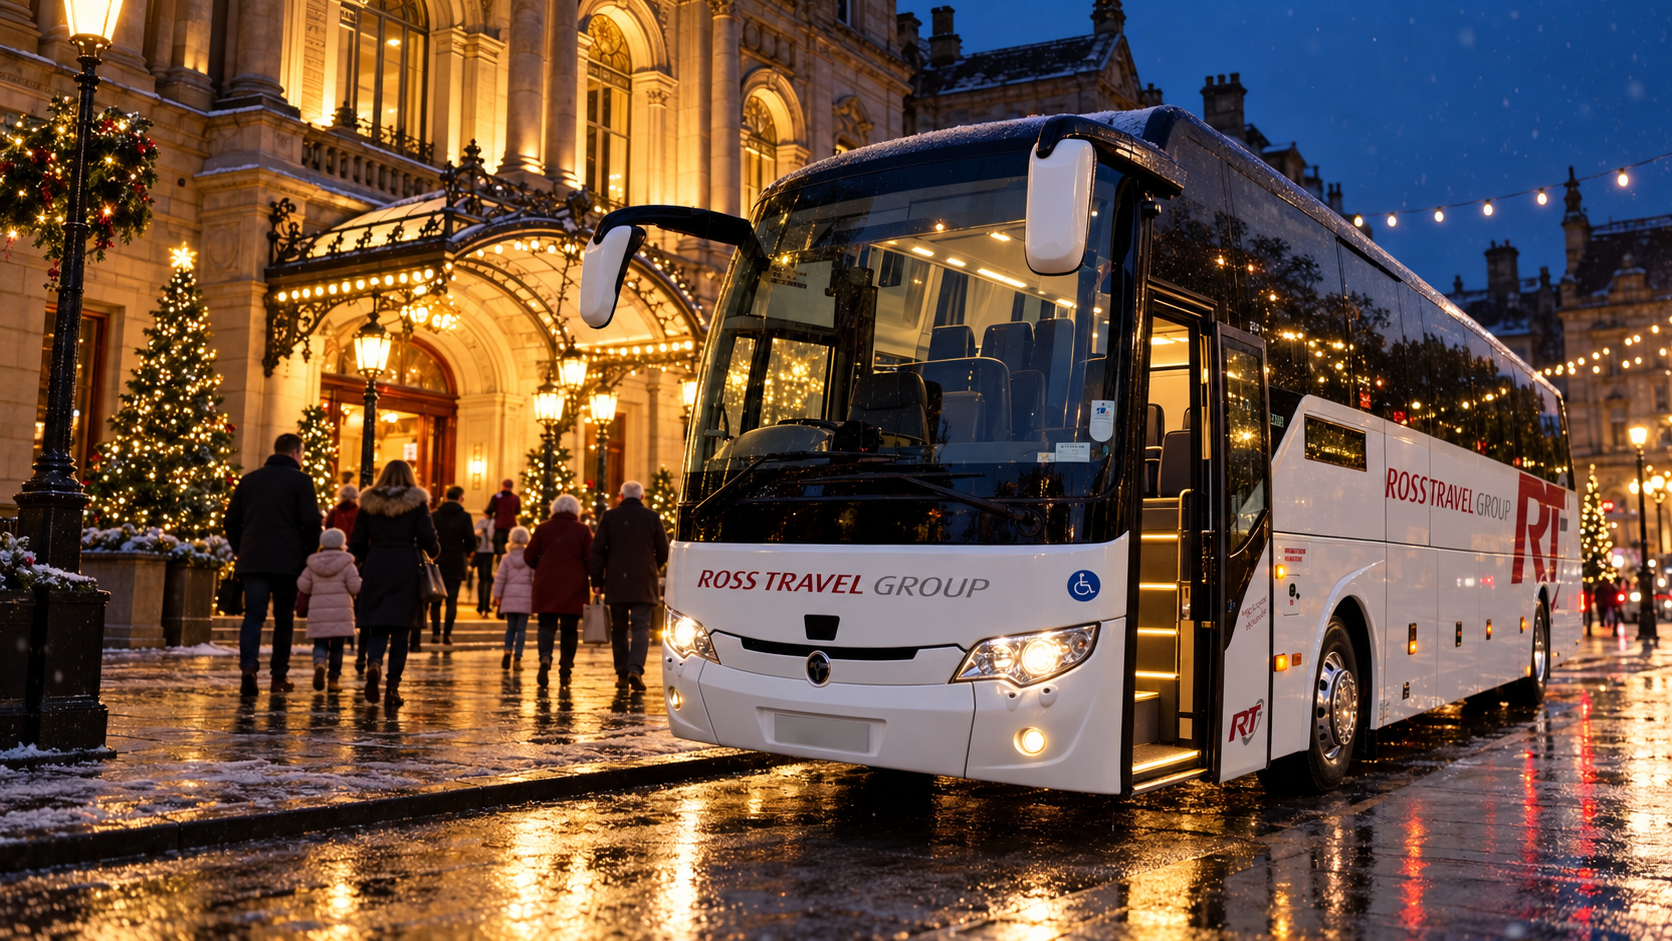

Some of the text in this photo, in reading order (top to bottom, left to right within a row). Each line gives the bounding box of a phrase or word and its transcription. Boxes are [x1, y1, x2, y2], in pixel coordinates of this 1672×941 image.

[1385, 467, 1511, 521] ROSS TRAVEL GROUP
[697, 569, 990, 599] ROSS TRAVEL GROUP
